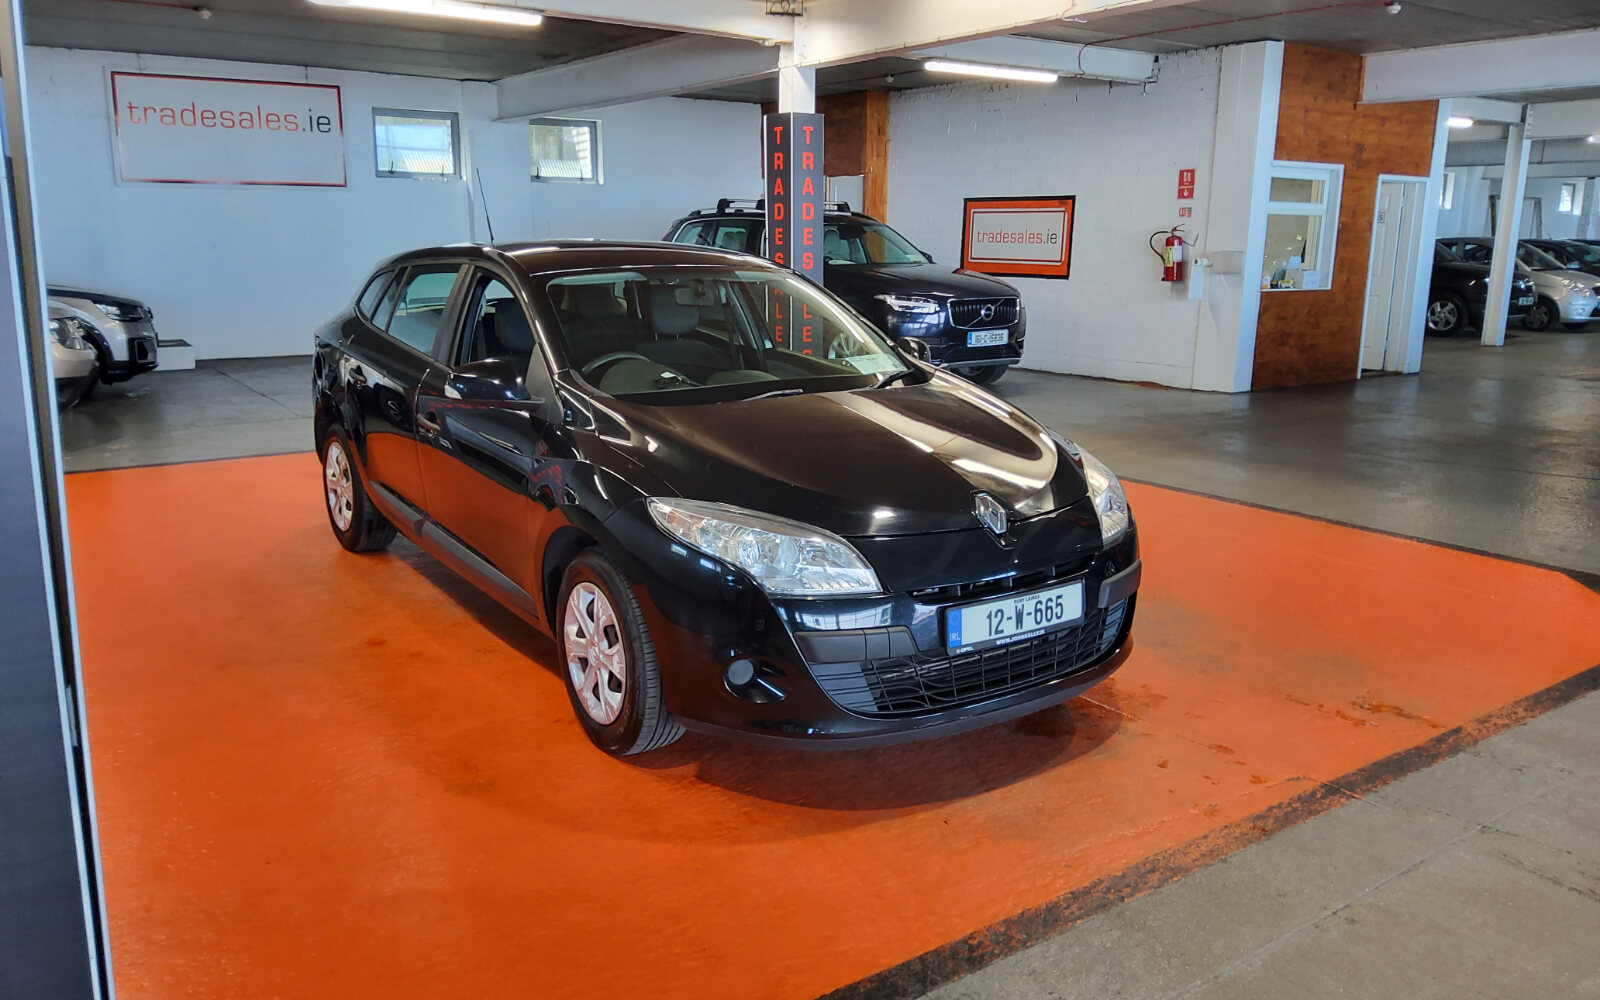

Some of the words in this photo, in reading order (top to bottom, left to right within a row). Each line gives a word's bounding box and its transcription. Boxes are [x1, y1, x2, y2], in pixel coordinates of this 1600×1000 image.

[126, 101, 332, 133] tradesales.ie
[977, 228, 1058, 244] tradesales.ie
[986, 594, 1064, 637] 12-W-665
[949, 632, 961, 642] IRL
